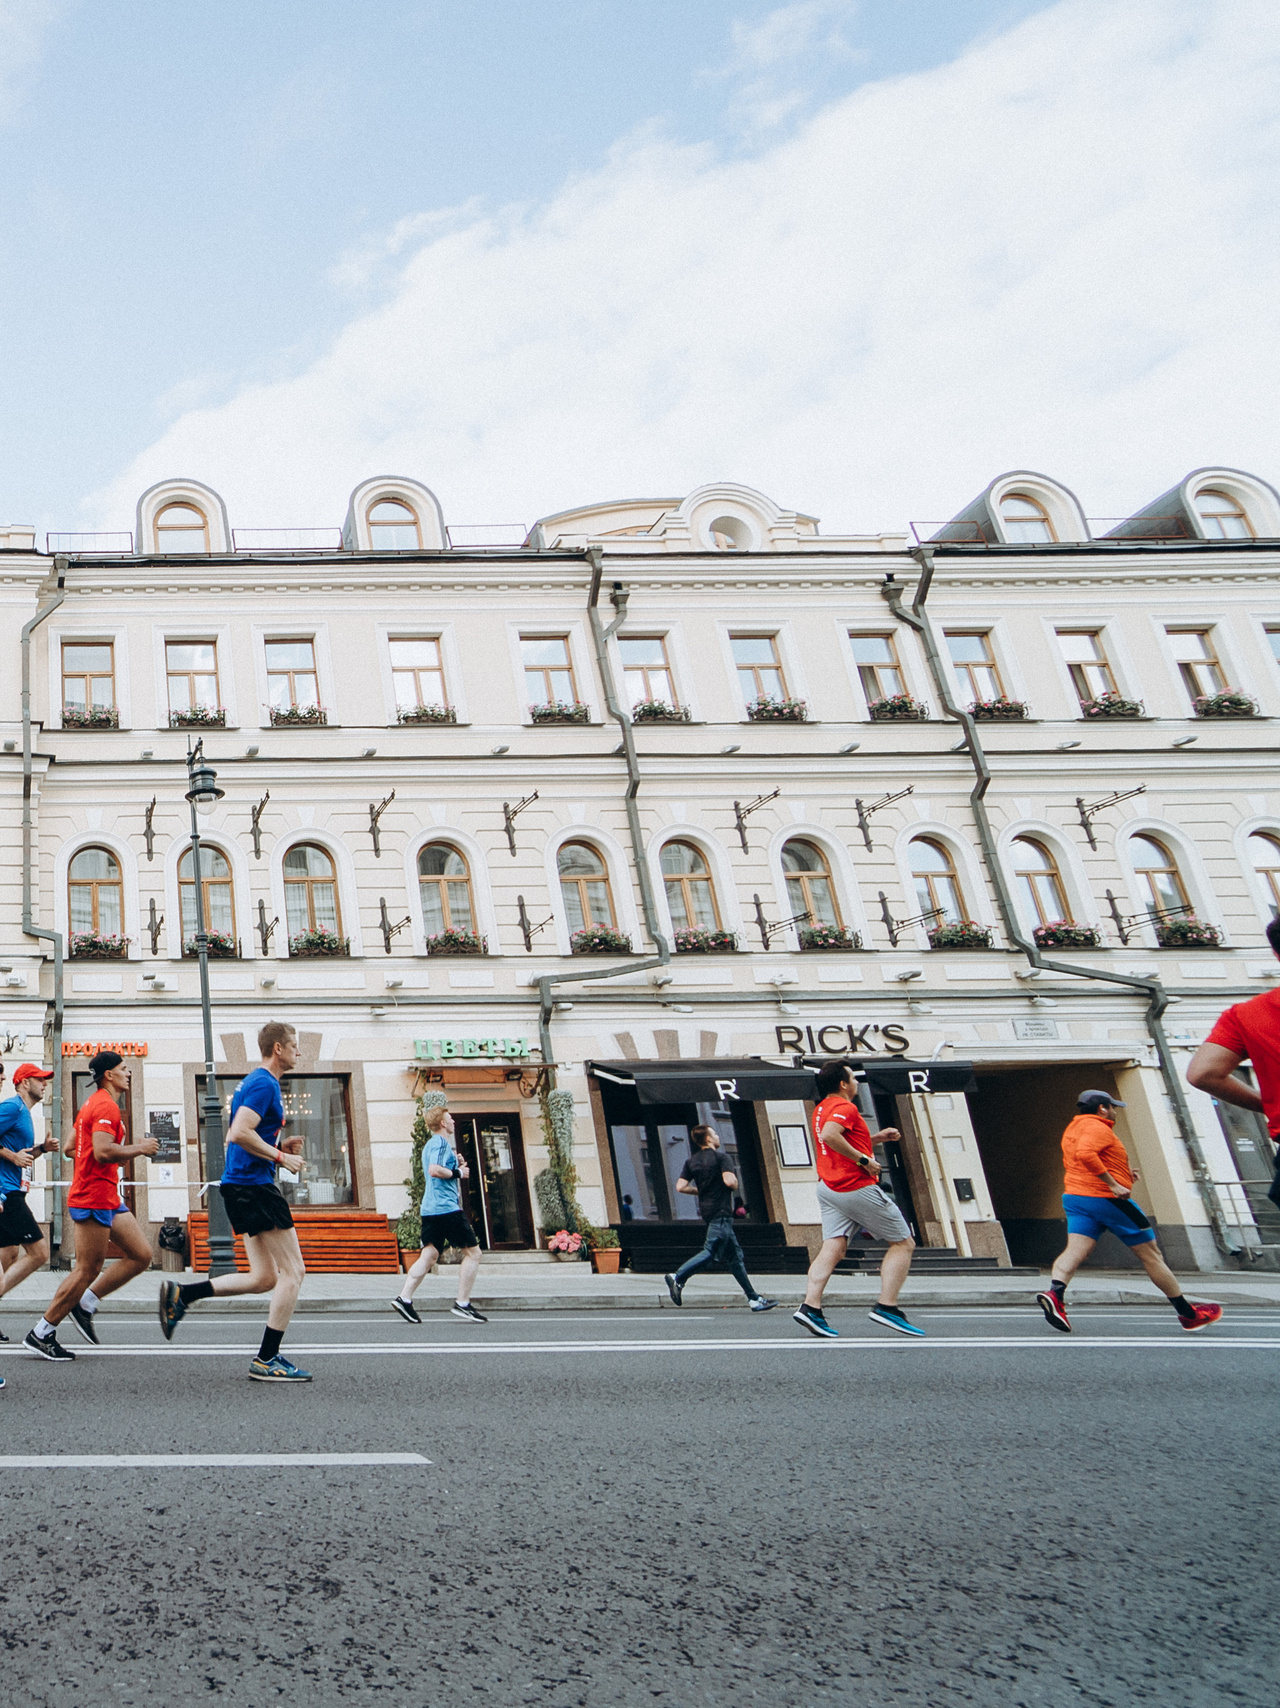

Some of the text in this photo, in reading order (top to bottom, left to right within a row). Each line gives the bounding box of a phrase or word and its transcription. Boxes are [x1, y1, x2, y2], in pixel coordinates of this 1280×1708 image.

[61, 1042, 149, 1058] ПРОДУКТЫ
[413, 1037, 530, 1061] ЦВЕТЫ
[775, 1023, 910, 1054] RICK'S
